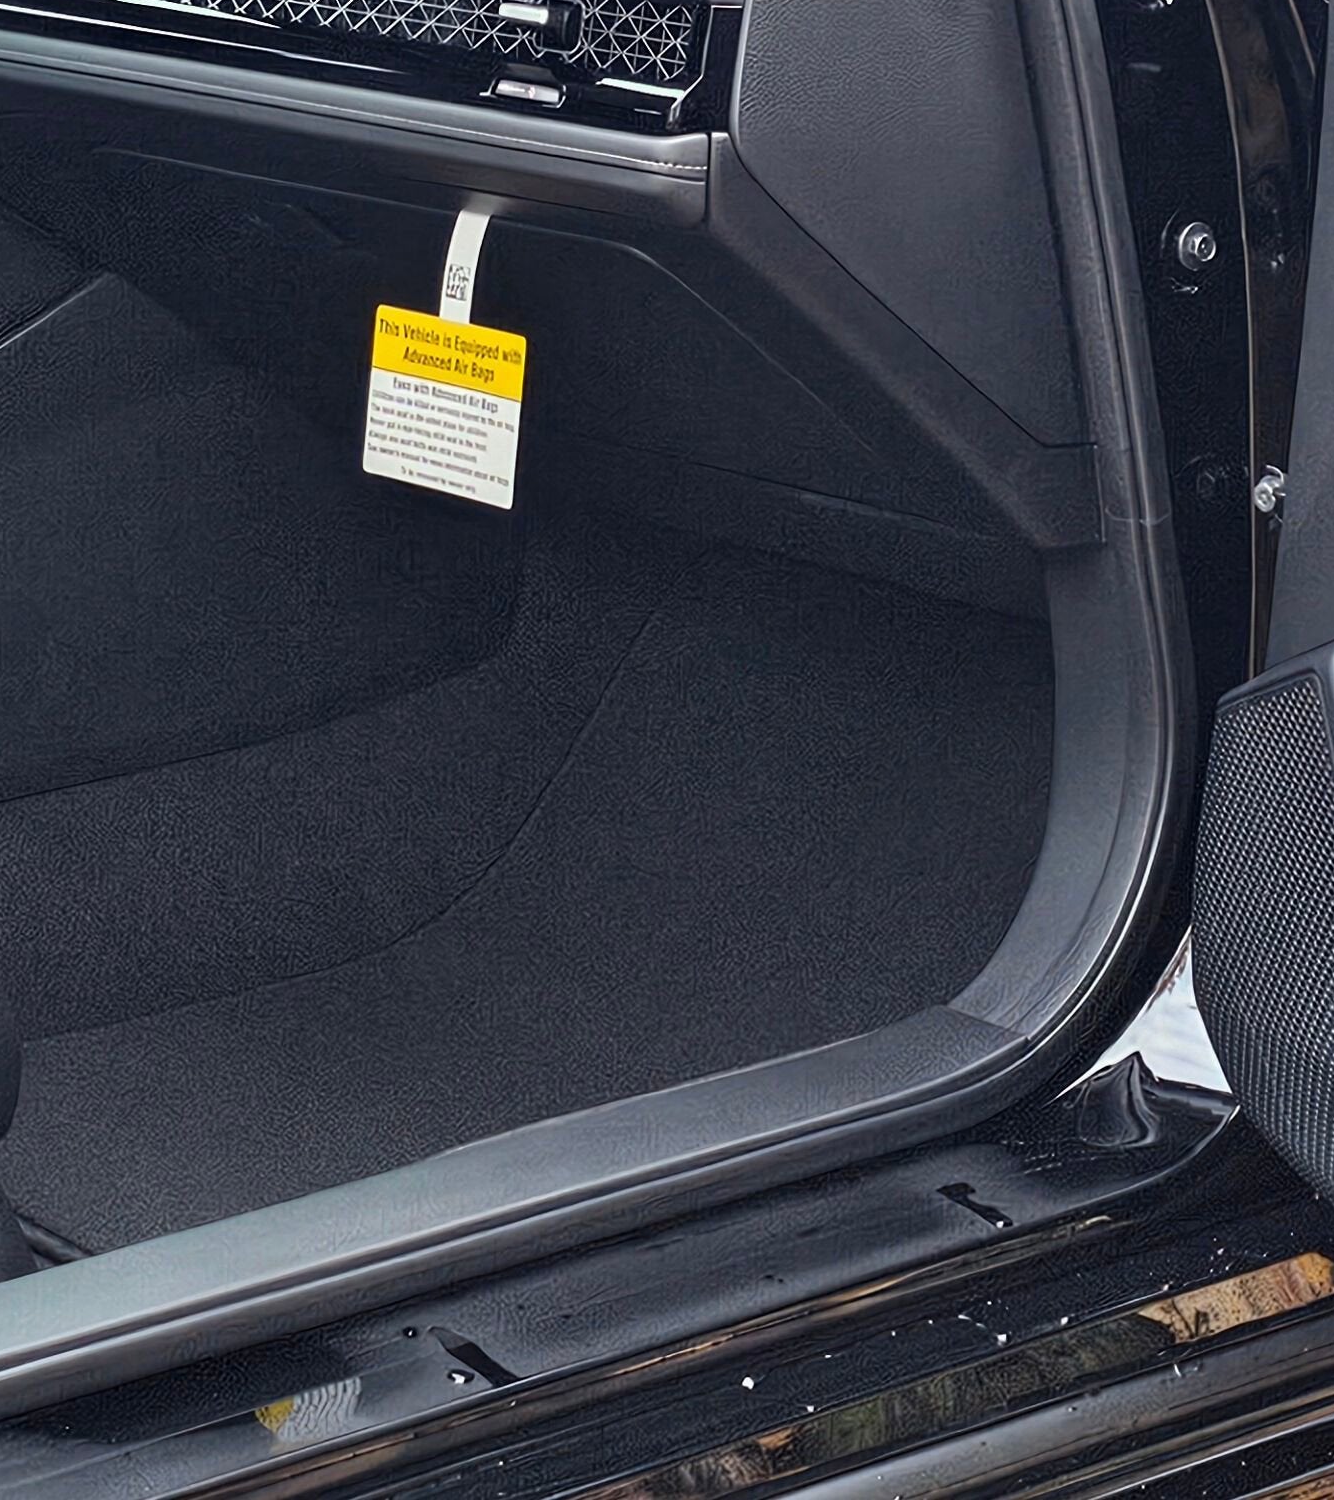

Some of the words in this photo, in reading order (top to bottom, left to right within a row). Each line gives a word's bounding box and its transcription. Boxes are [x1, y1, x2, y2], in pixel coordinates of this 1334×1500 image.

[379, 318, 399, 337] This
[403, 323, 440, 346] Vehicle
[442, 331, 452, 349] is
[454, 335, 500, 360] Equipped
[502, 348, 522, 365] with
[402, 346, 452, 371] Advanced
[454, 359, 468, 375] Air
[471, 362, 495, 384] Bags
